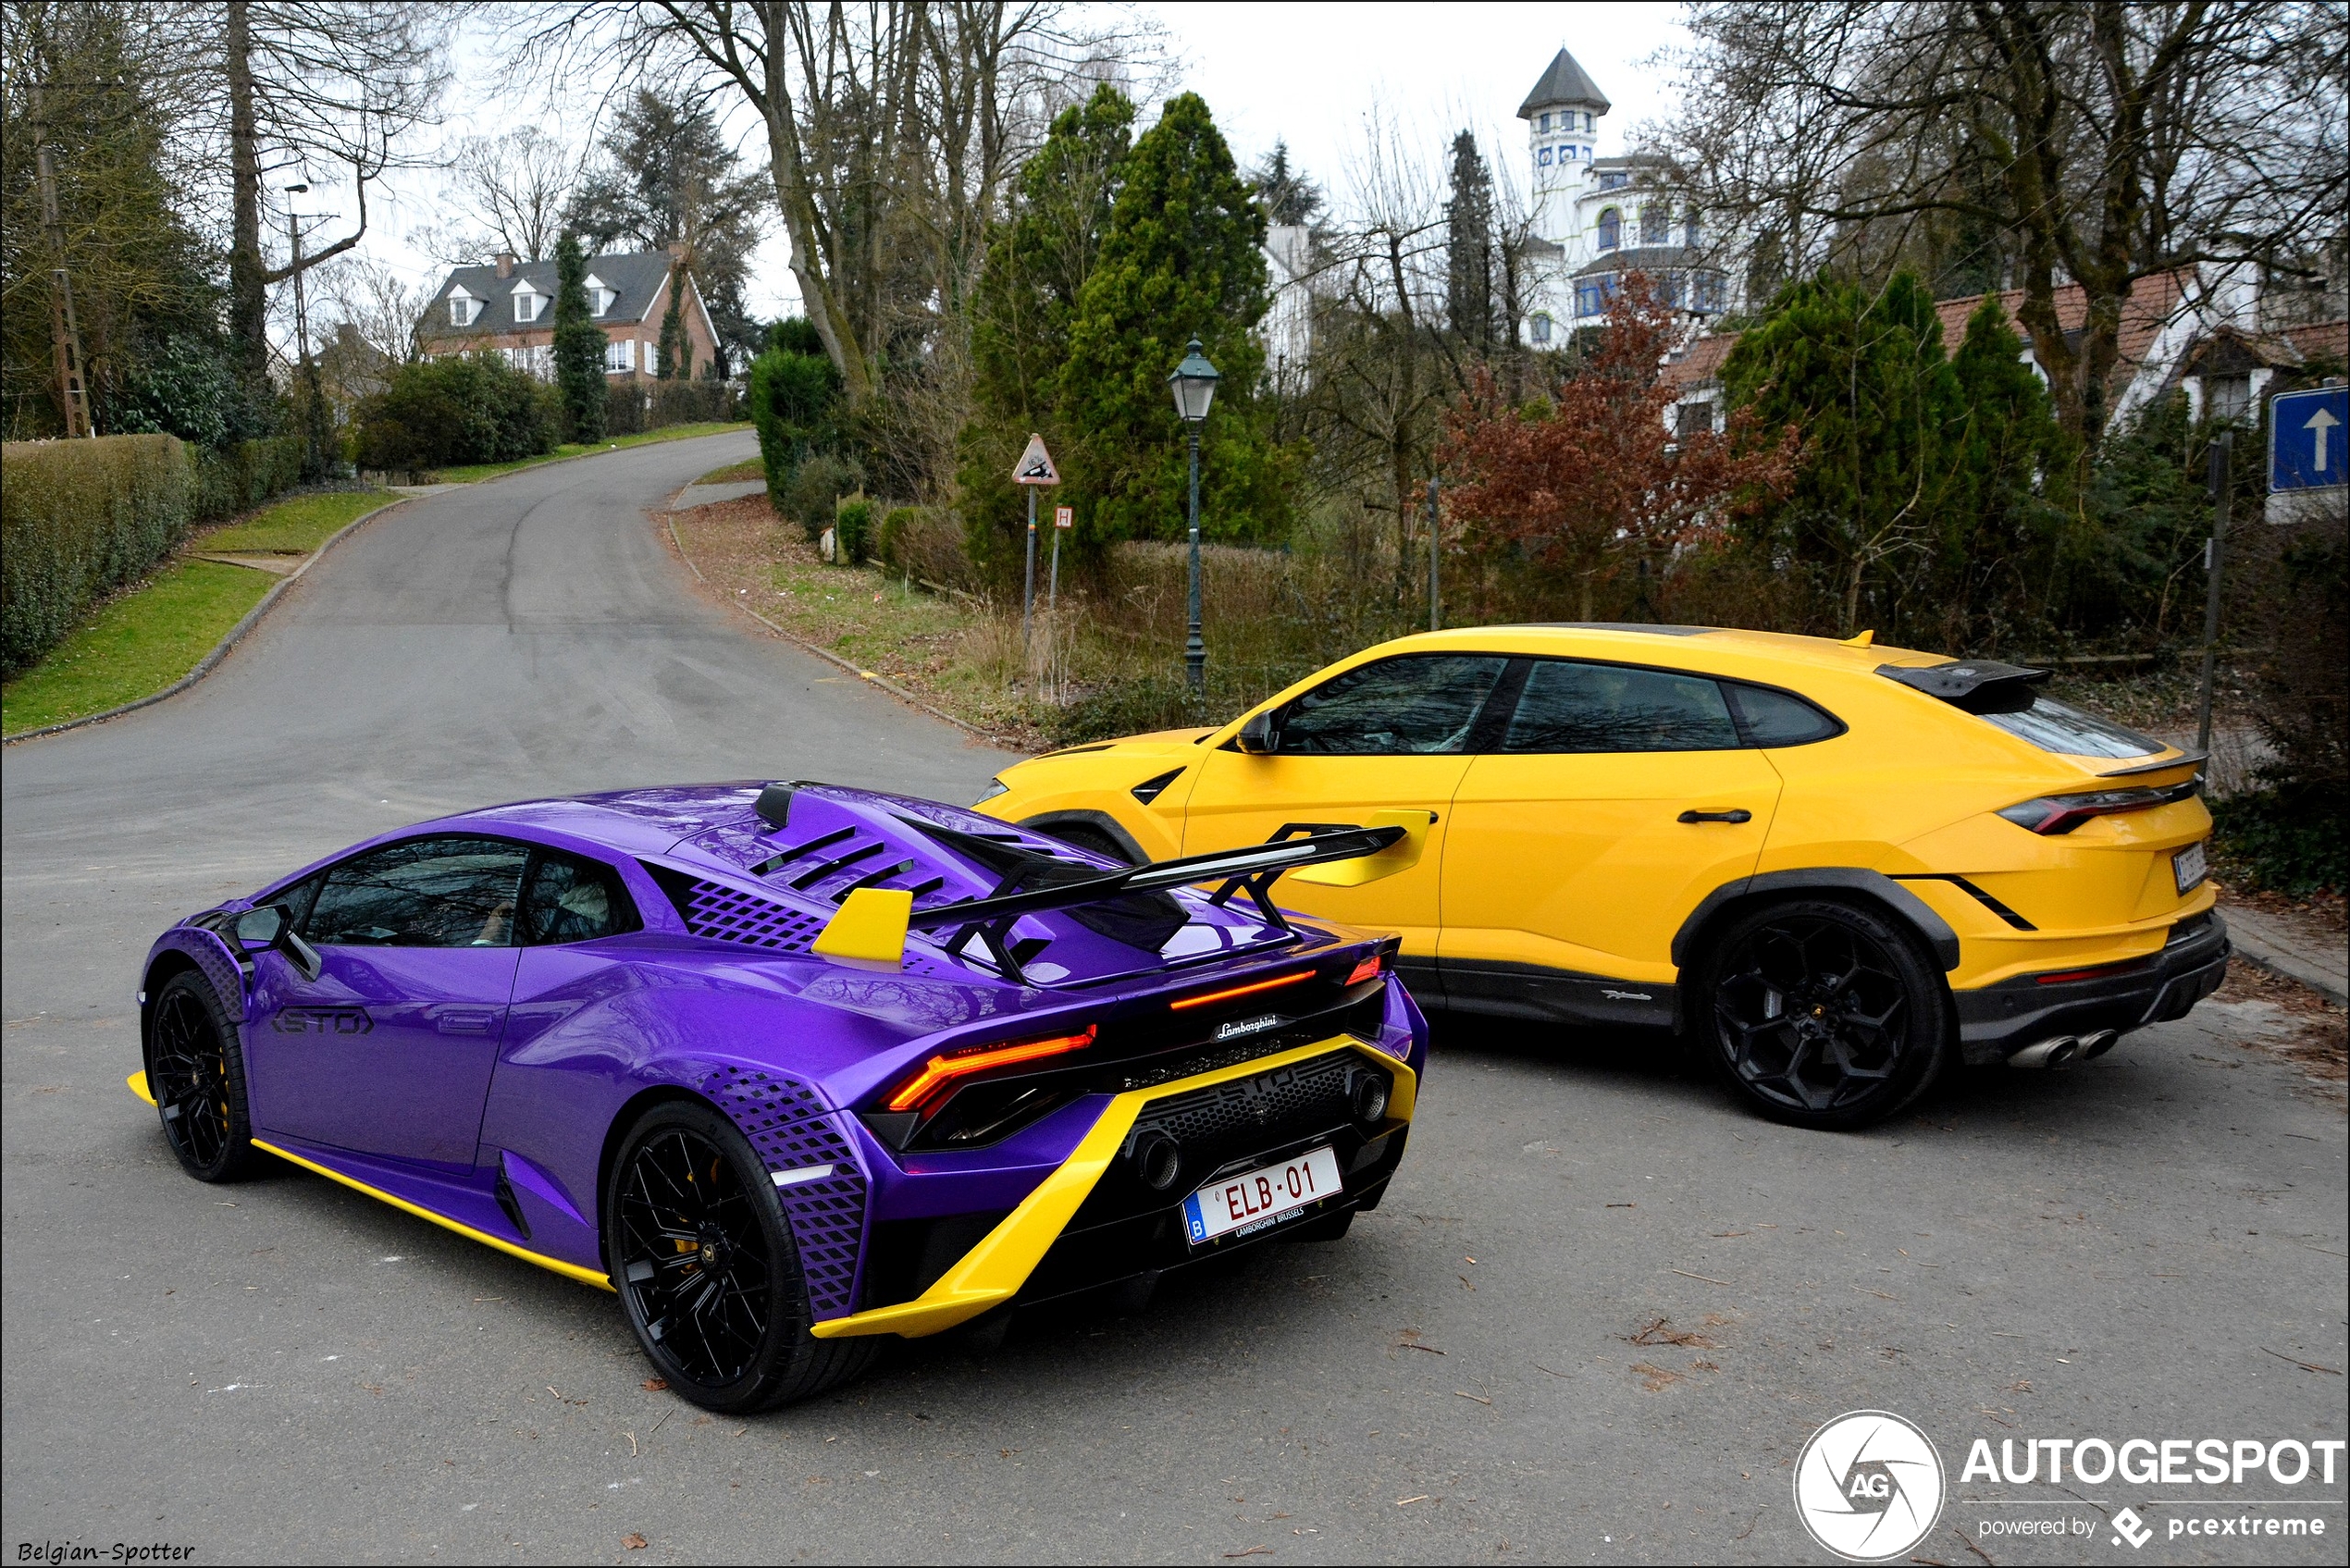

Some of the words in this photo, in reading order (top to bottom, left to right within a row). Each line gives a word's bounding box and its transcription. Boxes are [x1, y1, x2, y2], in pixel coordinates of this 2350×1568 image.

[1059, 511, 1069, 524] H
[284, 1012, 360, 1034] STO
[1217, 1014, 1278, 1039] Lamborghini
[1225, 1161, 1316, 1221] ELB-01
[1192, 1220, 1203, 1237] B
[1235, 1216, 1276, 1238] LAMBORGHINI
[1277, 1206, 1305, 1224] BRUSSELS
